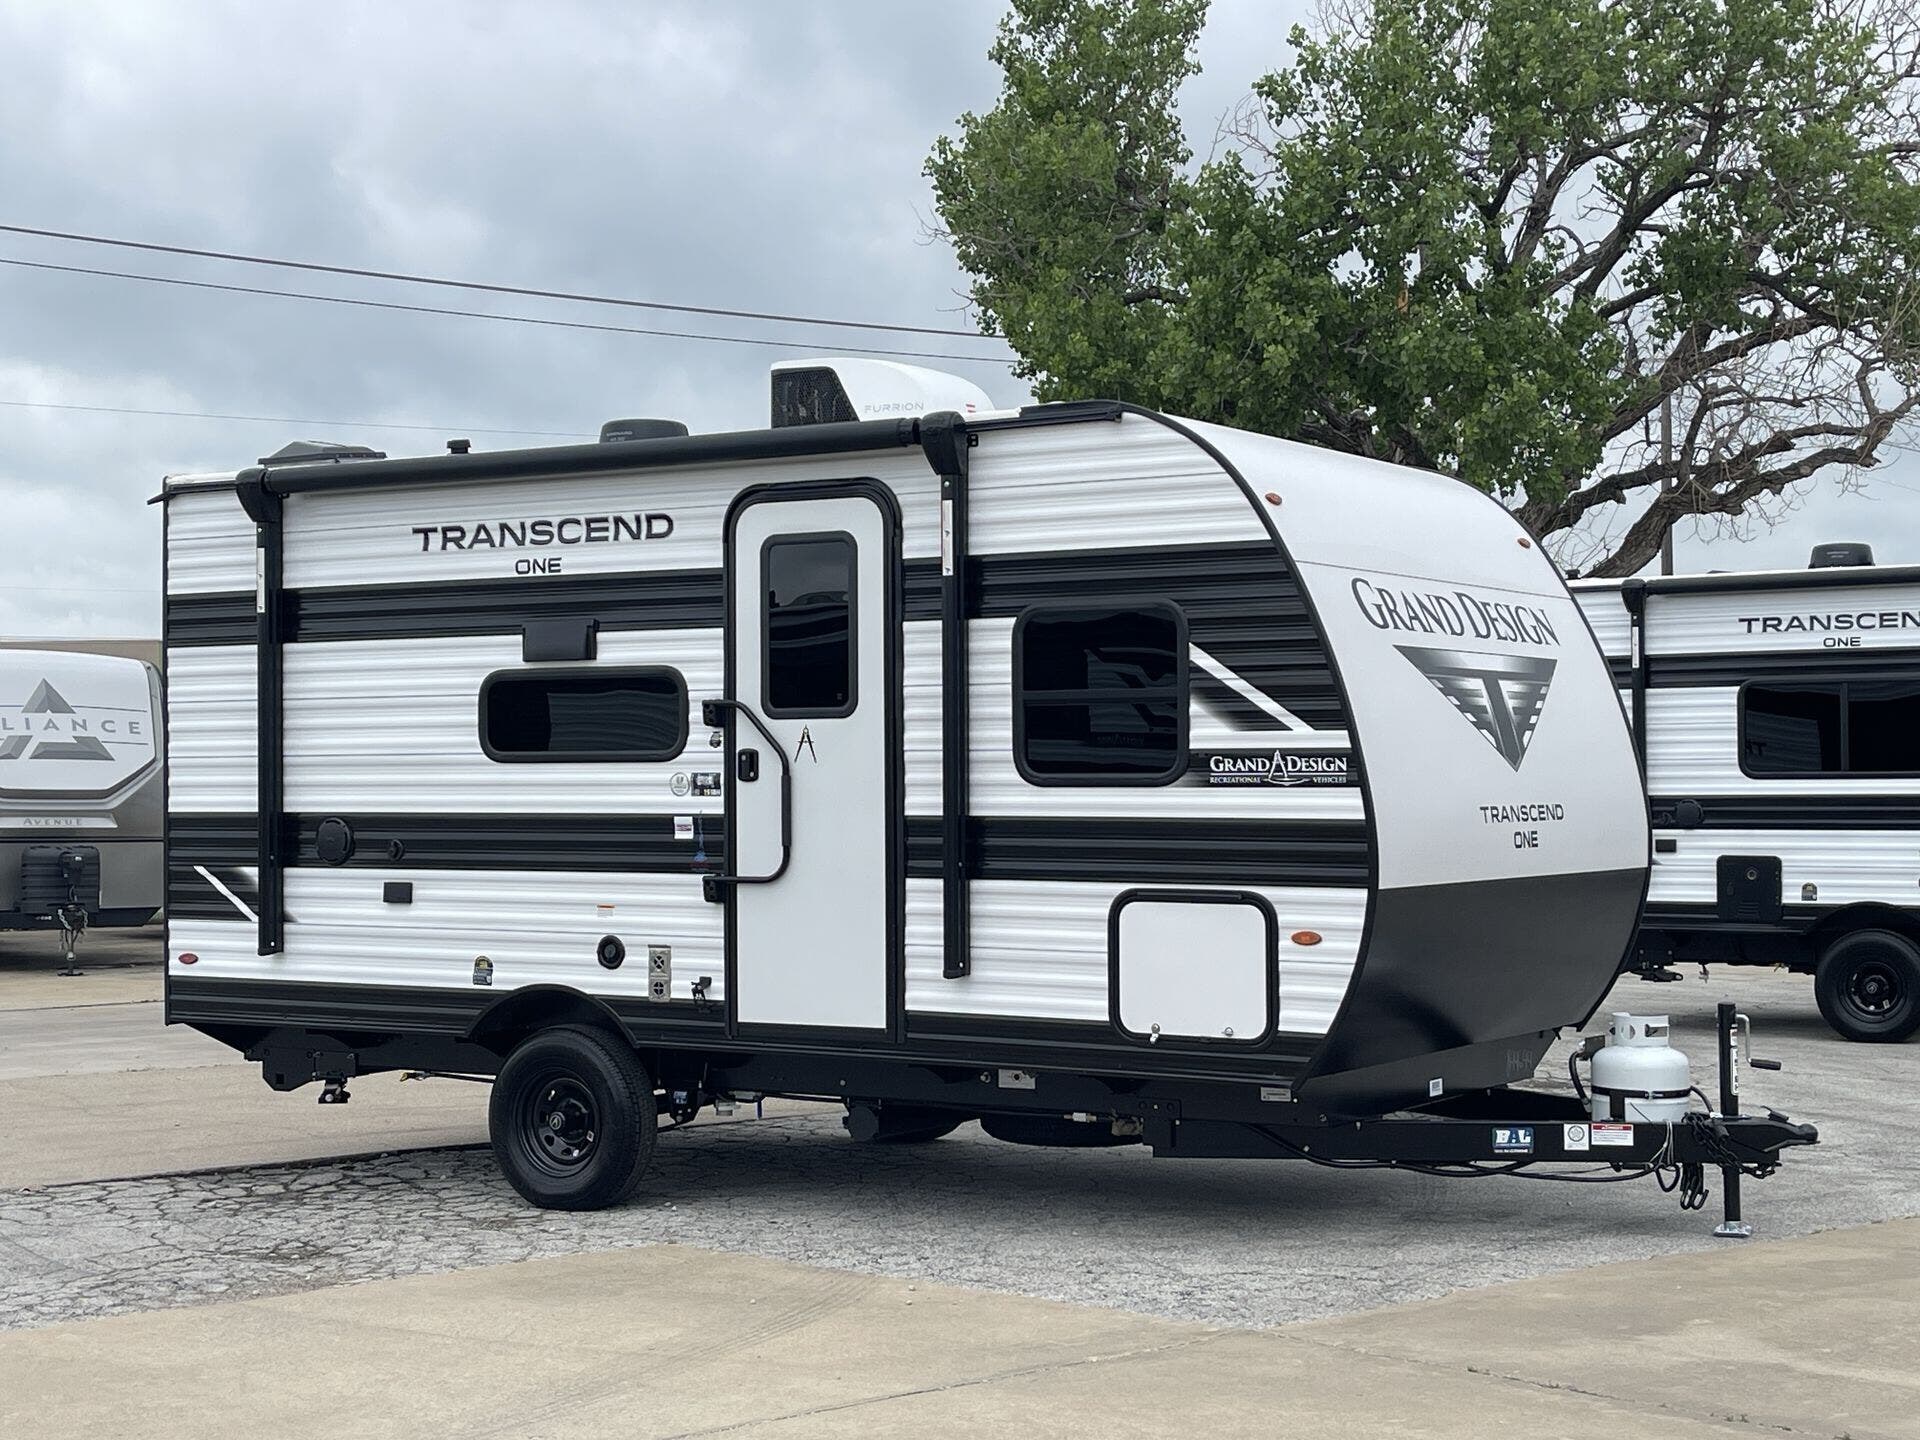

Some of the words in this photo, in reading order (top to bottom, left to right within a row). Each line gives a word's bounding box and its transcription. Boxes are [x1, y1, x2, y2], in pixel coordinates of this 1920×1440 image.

[864, 402, 924, 413] FURRION
[412, 513, 674, 551] TRANSCEND
[515, 557, 562, 574] ONE
[1351, 577, 1465, 636] GRAND
[1453, 591, 1560, 646] DESIGN
[1823, 637, 1861, 647] ONE
[1209, 756, 1270, 772] GRAND
[1285, 756, 1347, 772] DESIGN
[1209, 776, 1261, 784] RECREATIONAL
[1313, 776, 1347, 784] VEHICLES
[23, 817, 83, 826] AVENUE
[1480, 804, 1564, 823] TRANSCEND
[1513, 831, 1538, 848] ONE
